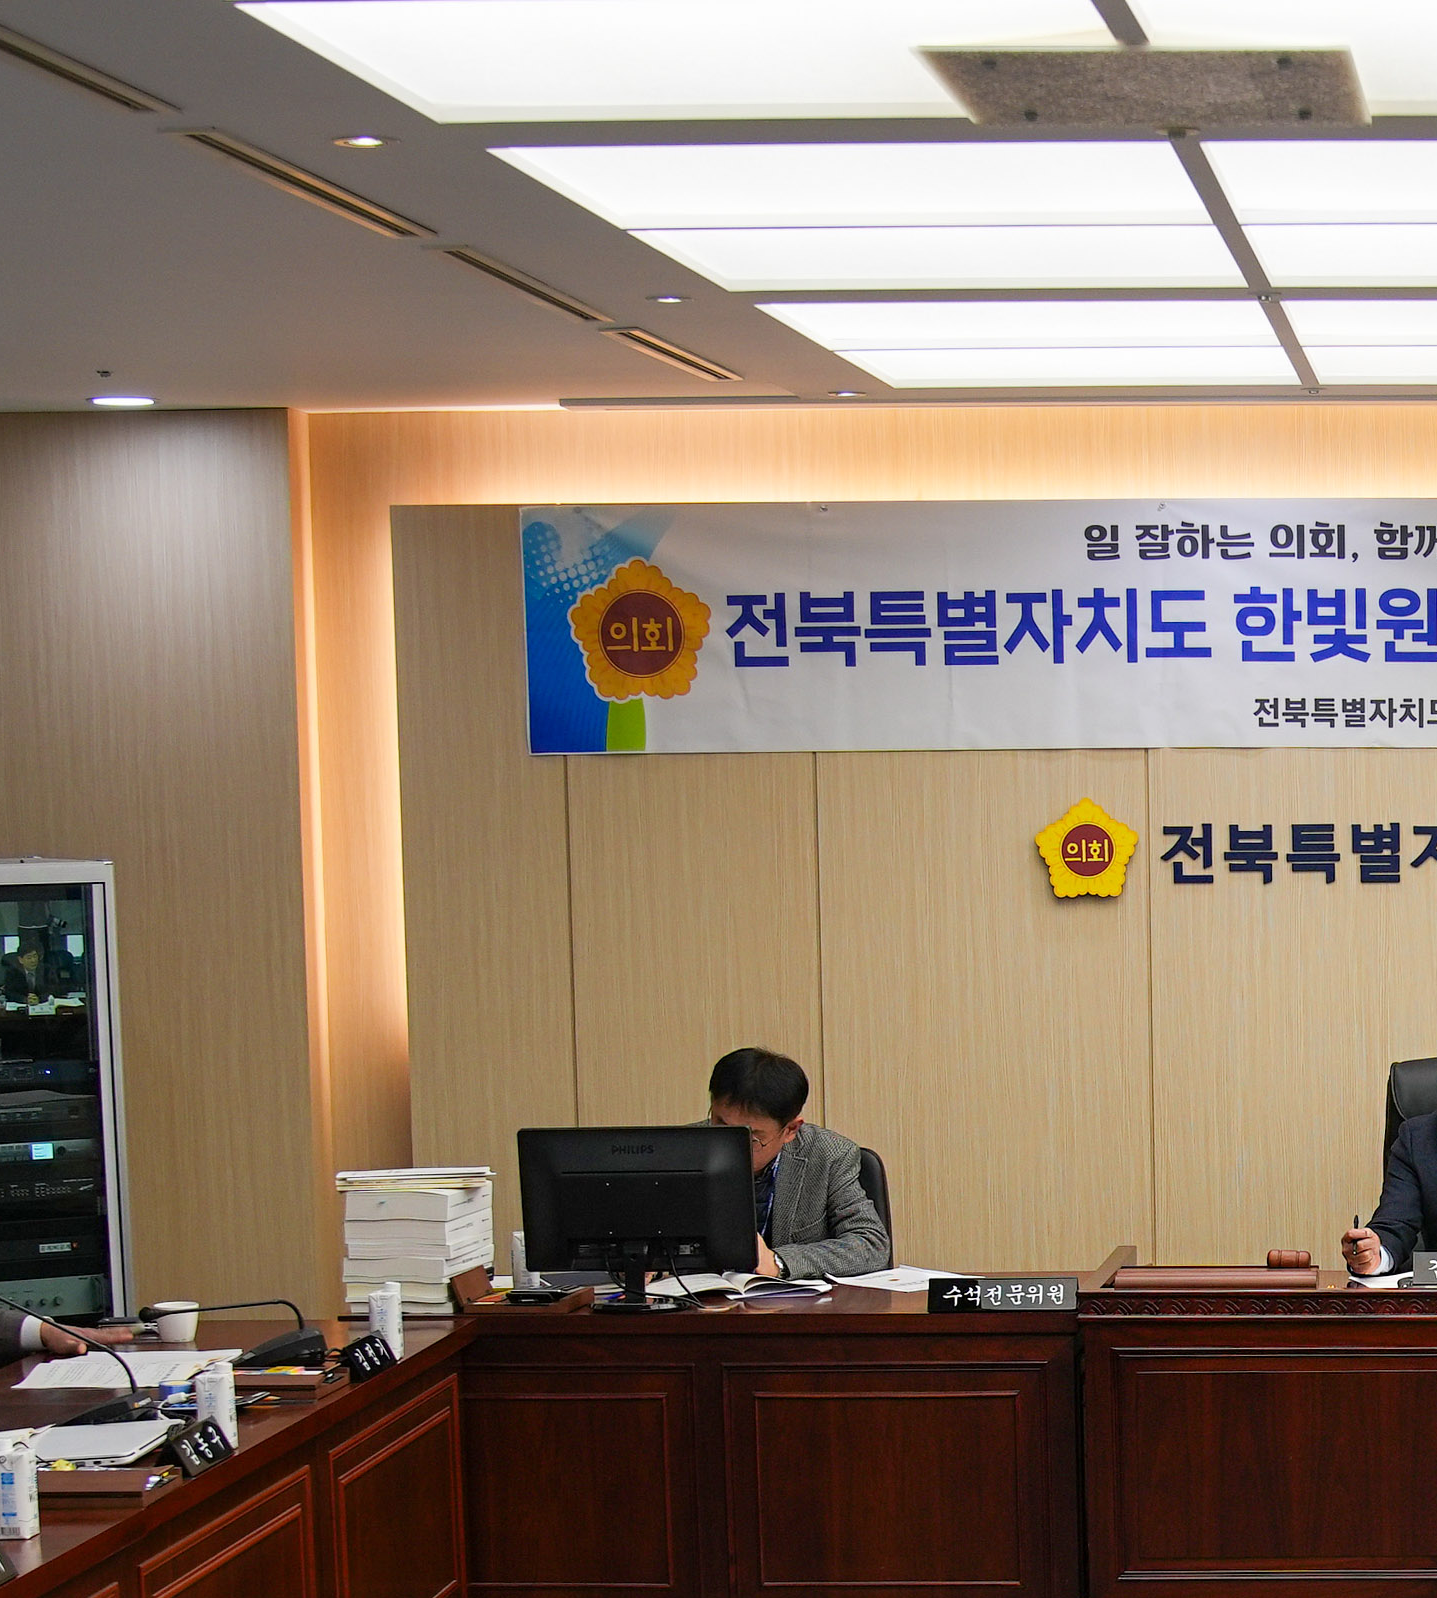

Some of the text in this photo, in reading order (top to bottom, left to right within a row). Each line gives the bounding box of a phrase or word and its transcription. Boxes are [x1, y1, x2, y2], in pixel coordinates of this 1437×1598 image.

[1084, 525, 1120, 560] 일
[1135, 521, 1254, 560] 잘하는
[1269, 521, 1358, 562] 의회,
[607, 617, 674, 652] 의회
[725, 588, 1211, 667] 전북특별자치도
[1065, 839, 1108, 863] 의회
[612, 1144, 654, 1155] PHILIPS
[943, 1284, 1064, 1306] 수석전문위원
[181, 1426, 225, 1465] 김동구
